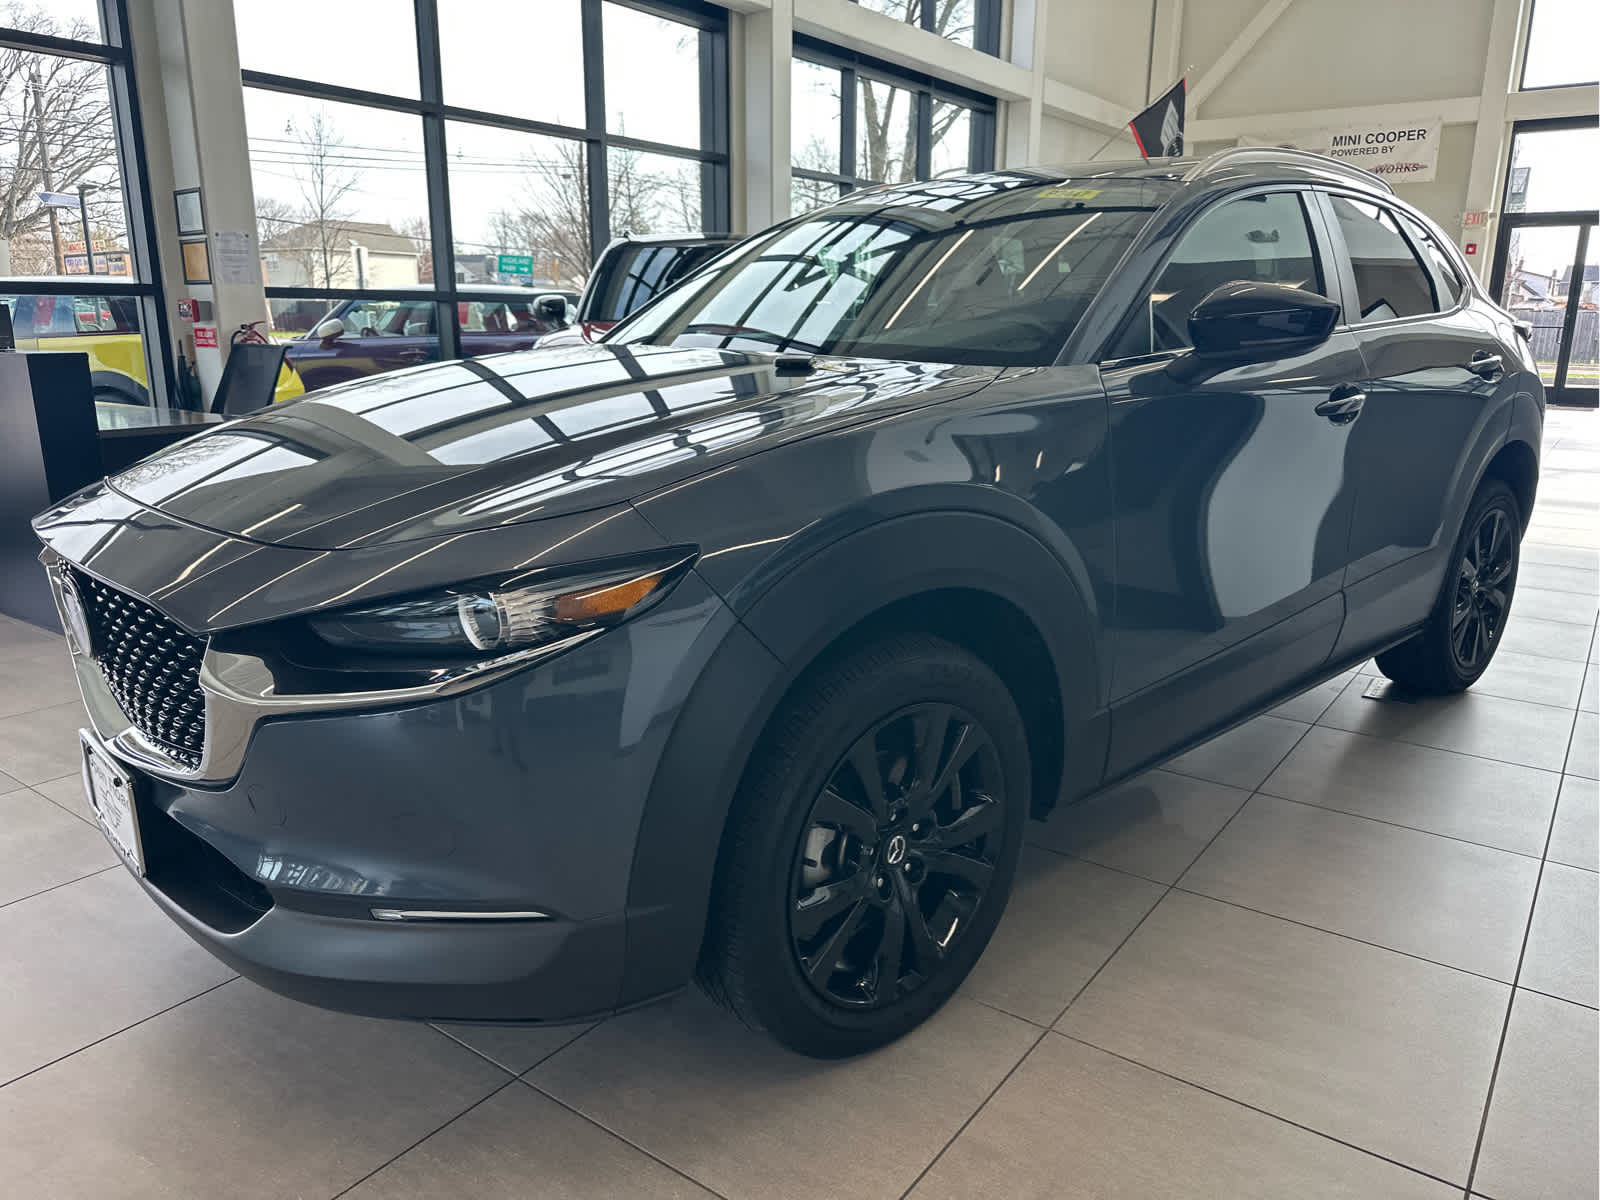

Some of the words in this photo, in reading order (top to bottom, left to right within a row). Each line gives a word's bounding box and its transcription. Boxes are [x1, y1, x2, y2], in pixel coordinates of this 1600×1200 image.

[1332, 134, 1361, 147] MINI
[1365, 128, 1427, 145] COOPER
[1331, 147, 1379, 157] POWERED
[1381, 145, 1395, 155] BY
[1465, 212, 1486, 225] EXIT
